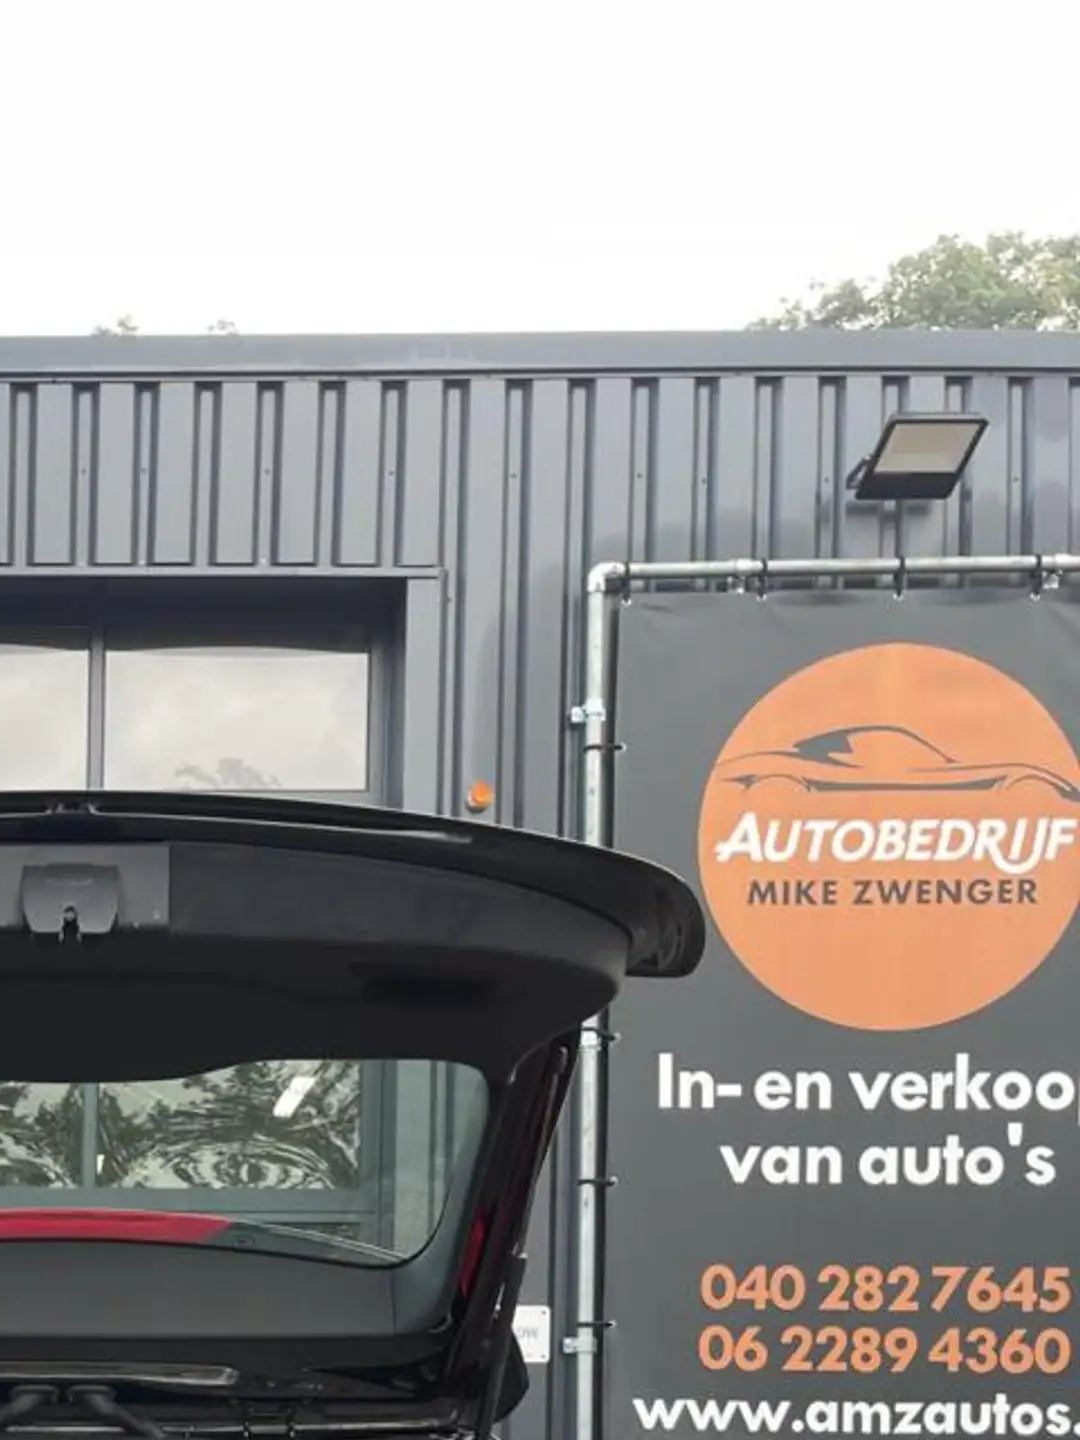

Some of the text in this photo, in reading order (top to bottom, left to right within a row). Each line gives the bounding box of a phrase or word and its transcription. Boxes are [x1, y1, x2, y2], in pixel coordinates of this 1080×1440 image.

[714, 811, 1078, 875] AUTOBEDRIJF
[748, 879, 1037, 905] MIKE ZWENGER
[658, 1052, 1080, 1128] In- en verkoo
[719, 1122, 1056, 1186] van auto's
[699, 1262, 1073, 1315] 040 282 7645
[696, 1324, 1074, 1375] 06 2289 4360
